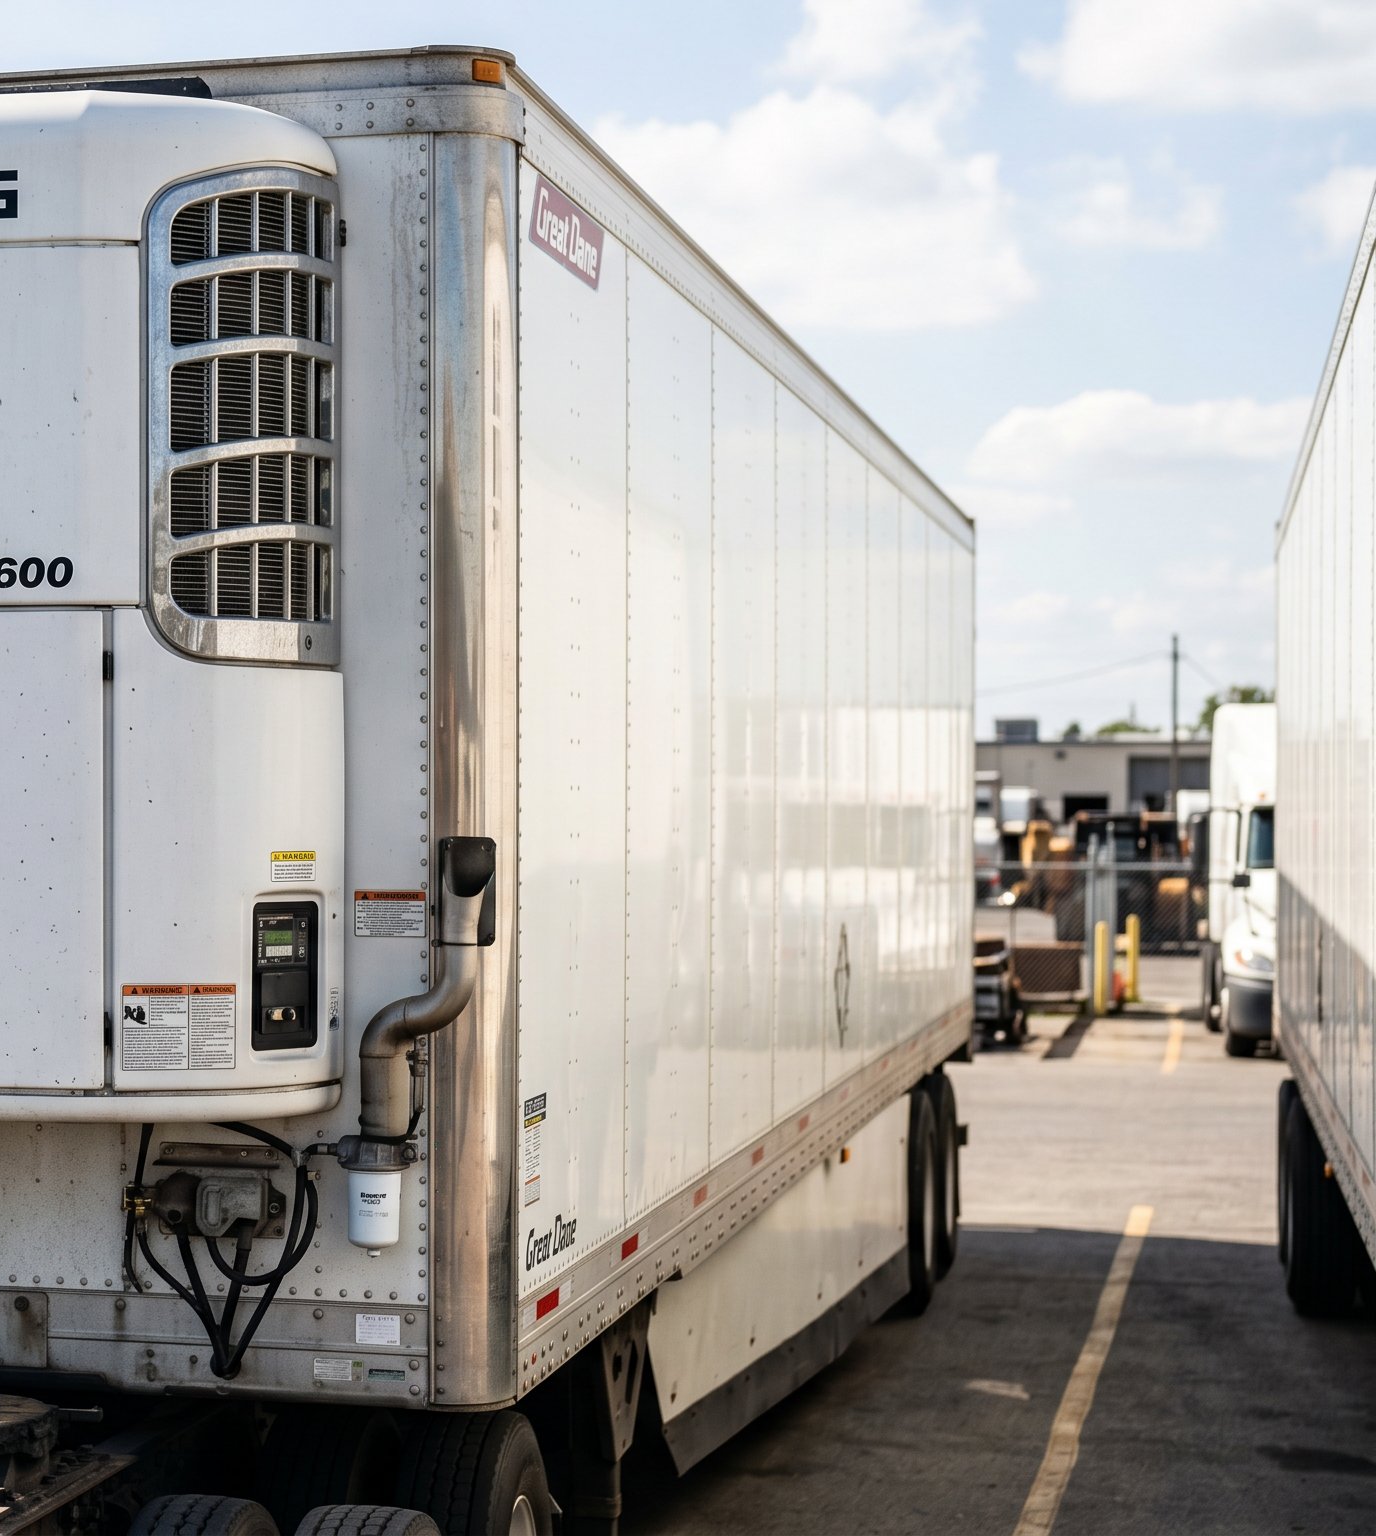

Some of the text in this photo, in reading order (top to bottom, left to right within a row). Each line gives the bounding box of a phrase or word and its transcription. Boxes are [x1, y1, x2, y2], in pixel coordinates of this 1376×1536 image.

[536, 186, 598, 280] Great Dane
[526, 1227, 553, 1272] Great
